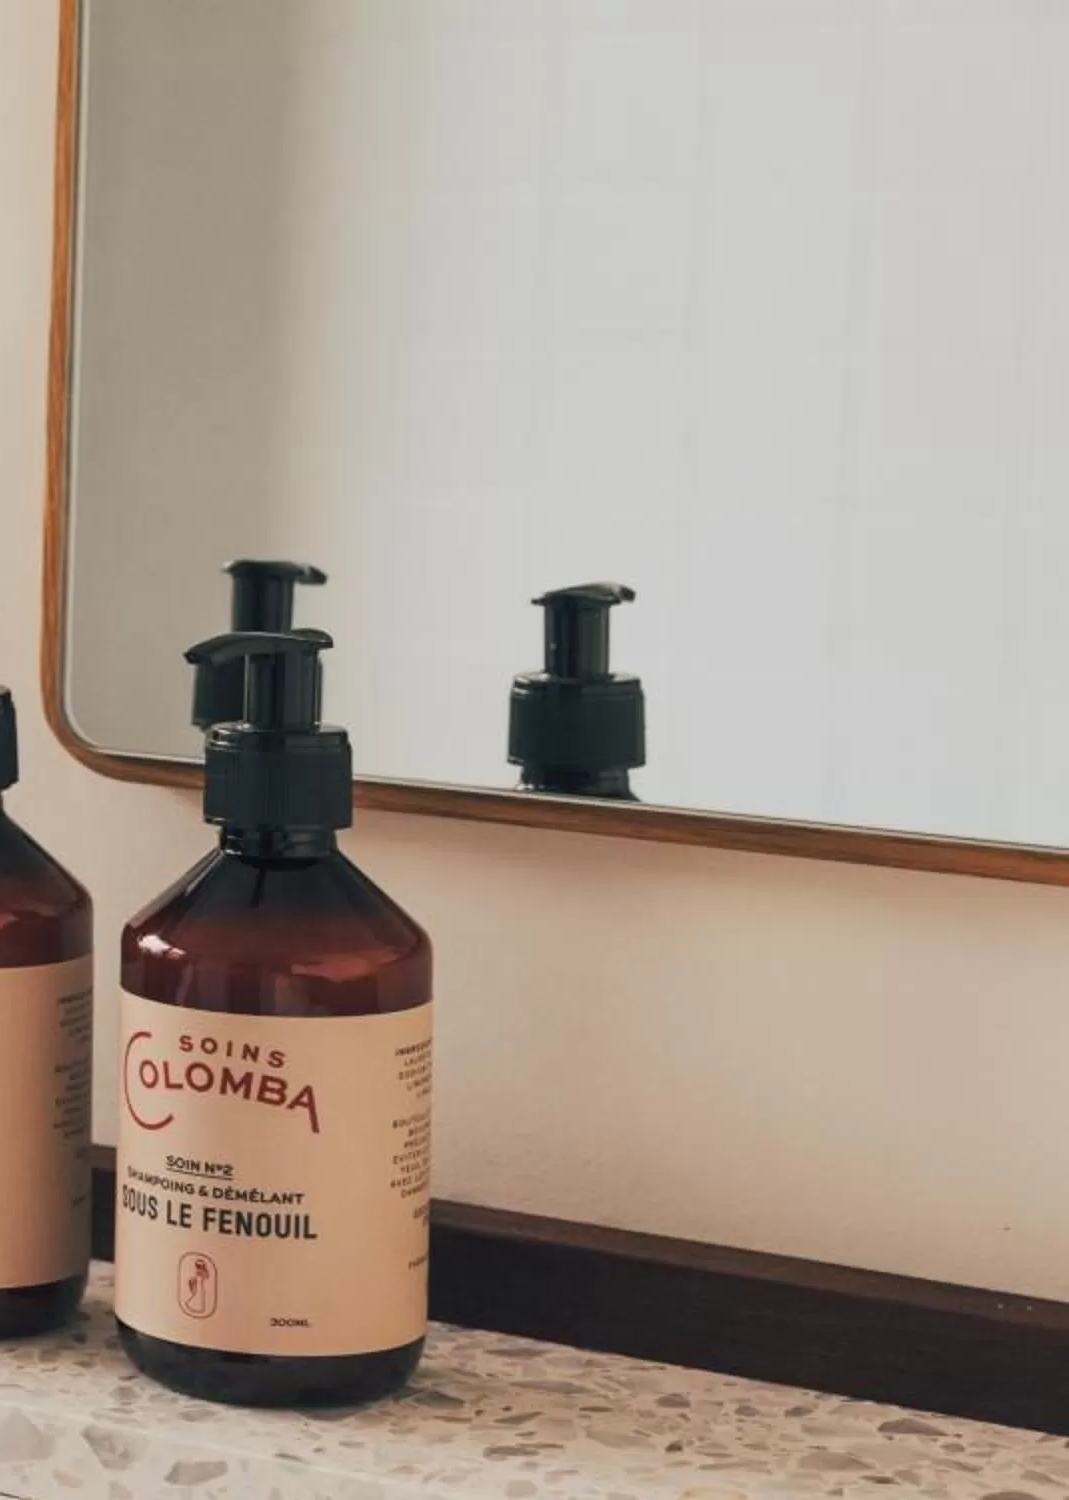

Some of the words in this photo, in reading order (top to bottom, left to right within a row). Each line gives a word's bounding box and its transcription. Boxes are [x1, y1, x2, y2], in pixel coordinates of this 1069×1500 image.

[179, 1035, 286, 1068] SOINS
[124, 1031, 320, 1134] COLOMBA
[166, 1155, 200, 1173] SOIN
[198, 1186, 208, 1198] &
[122, 1184, 158, 1220] SOUS
[166, 1199, 193, 1228] LE
[202, 1206, 318, 1240] FENOUIL
